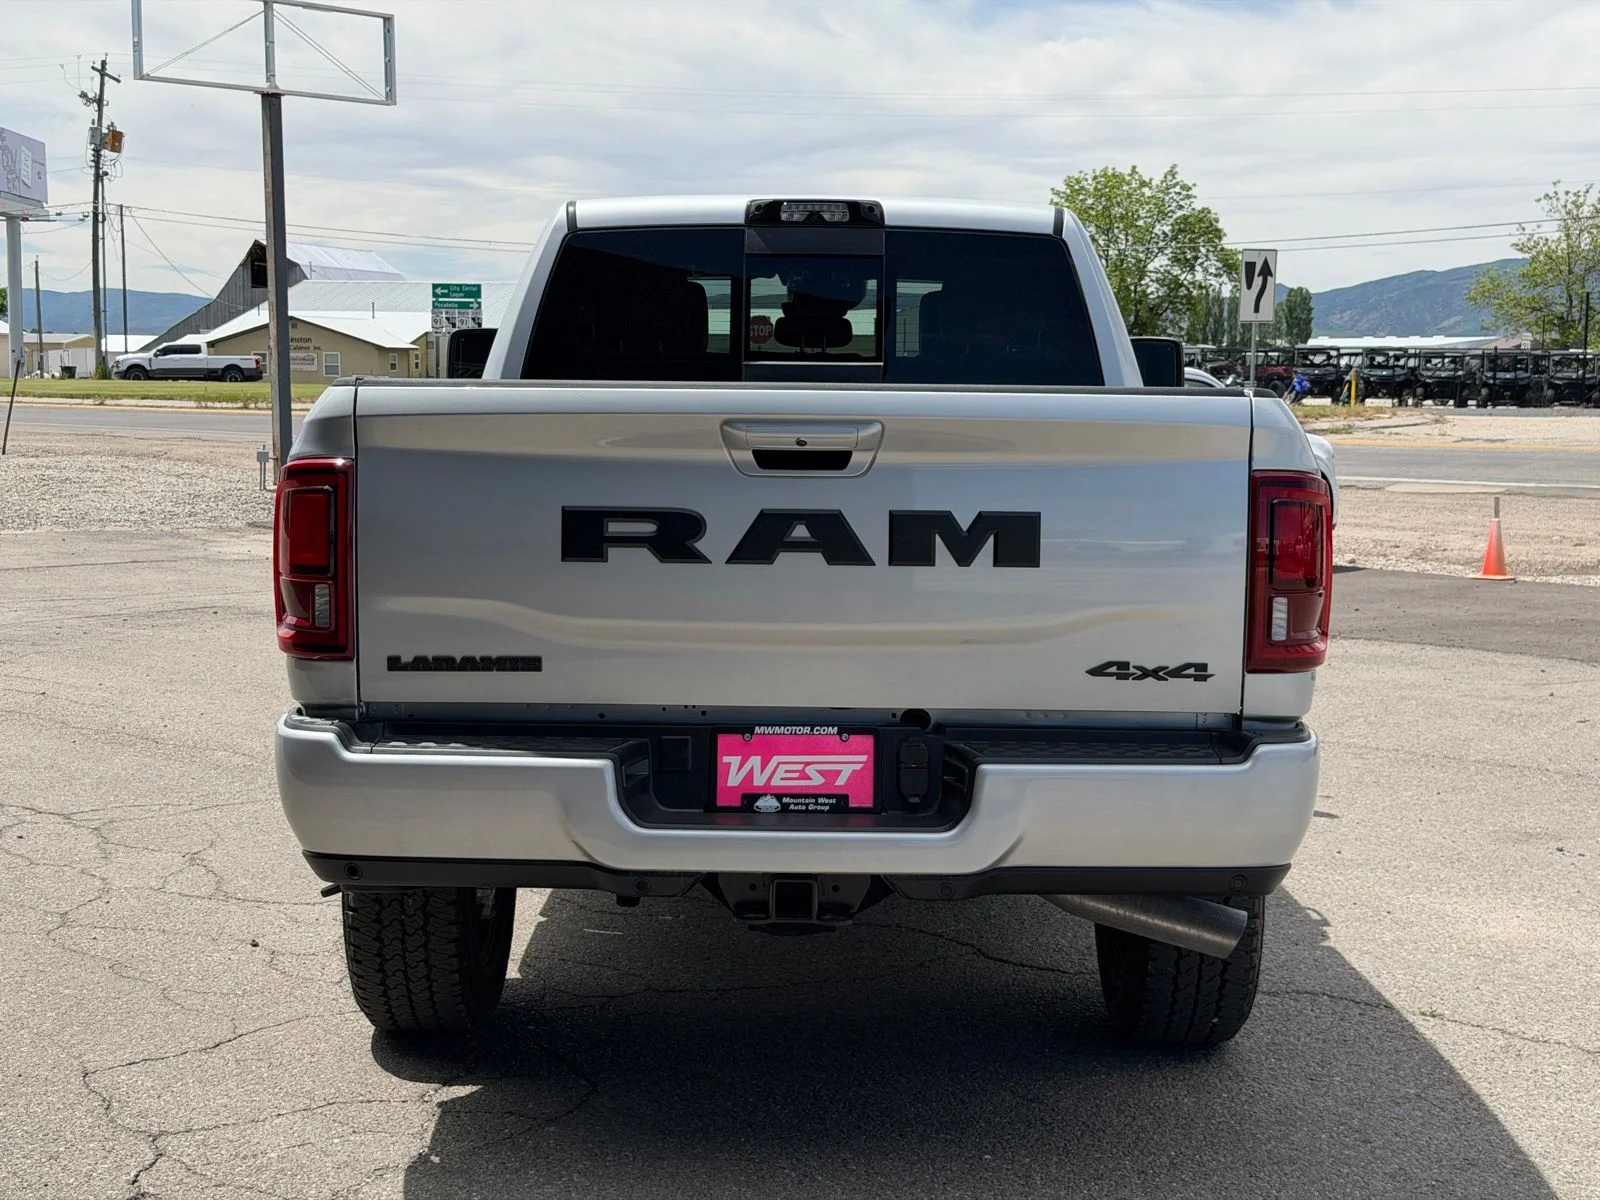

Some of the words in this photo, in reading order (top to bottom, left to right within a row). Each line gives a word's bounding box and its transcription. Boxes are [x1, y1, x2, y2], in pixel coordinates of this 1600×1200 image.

[560, 505, 1042, 569] RAM
[386, 655, 543, 672] LARAMIE
[1085, 660, 1216, 682] 4x4
[754, 726, 838, 735] MWMOTOR.COM
[722, 755, 869, 787] WEST
[782, 796, 816, 804] Mountain
[807, 804, 830, 812] Group
